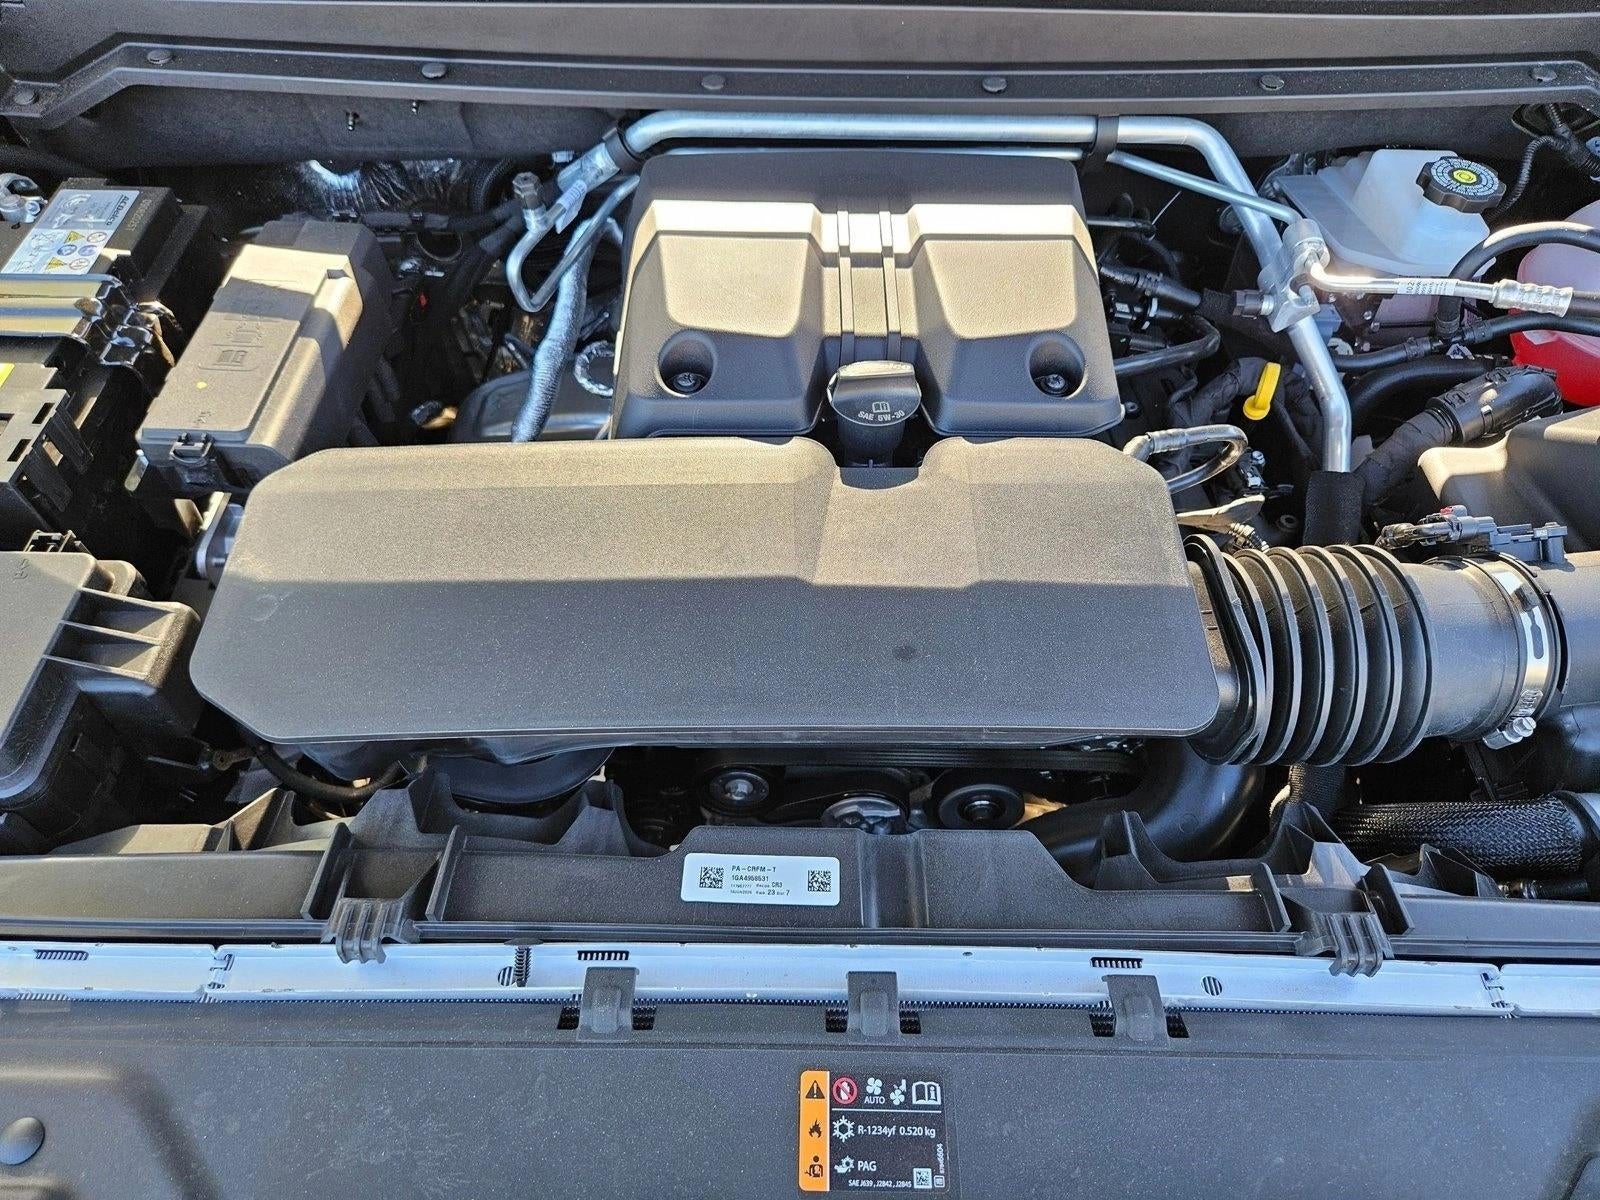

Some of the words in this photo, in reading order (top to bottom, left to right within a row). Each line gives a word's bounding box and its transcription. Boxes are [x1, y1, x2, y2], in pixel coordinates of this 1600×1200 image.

[858, 411, 875, 421] SAE
[877, 410, 905, 421] 5W-30
[864, 1096, 885, 1104] AUTO
[857, 1125, 897, 1138] R-1234yf
[899, 1126, 923, 1136] 0.520
[924, 1126, 936, 1138] kg
[857, 1161, 877, 1172] PAG
[848, 1179, 860, 1187] SAE
